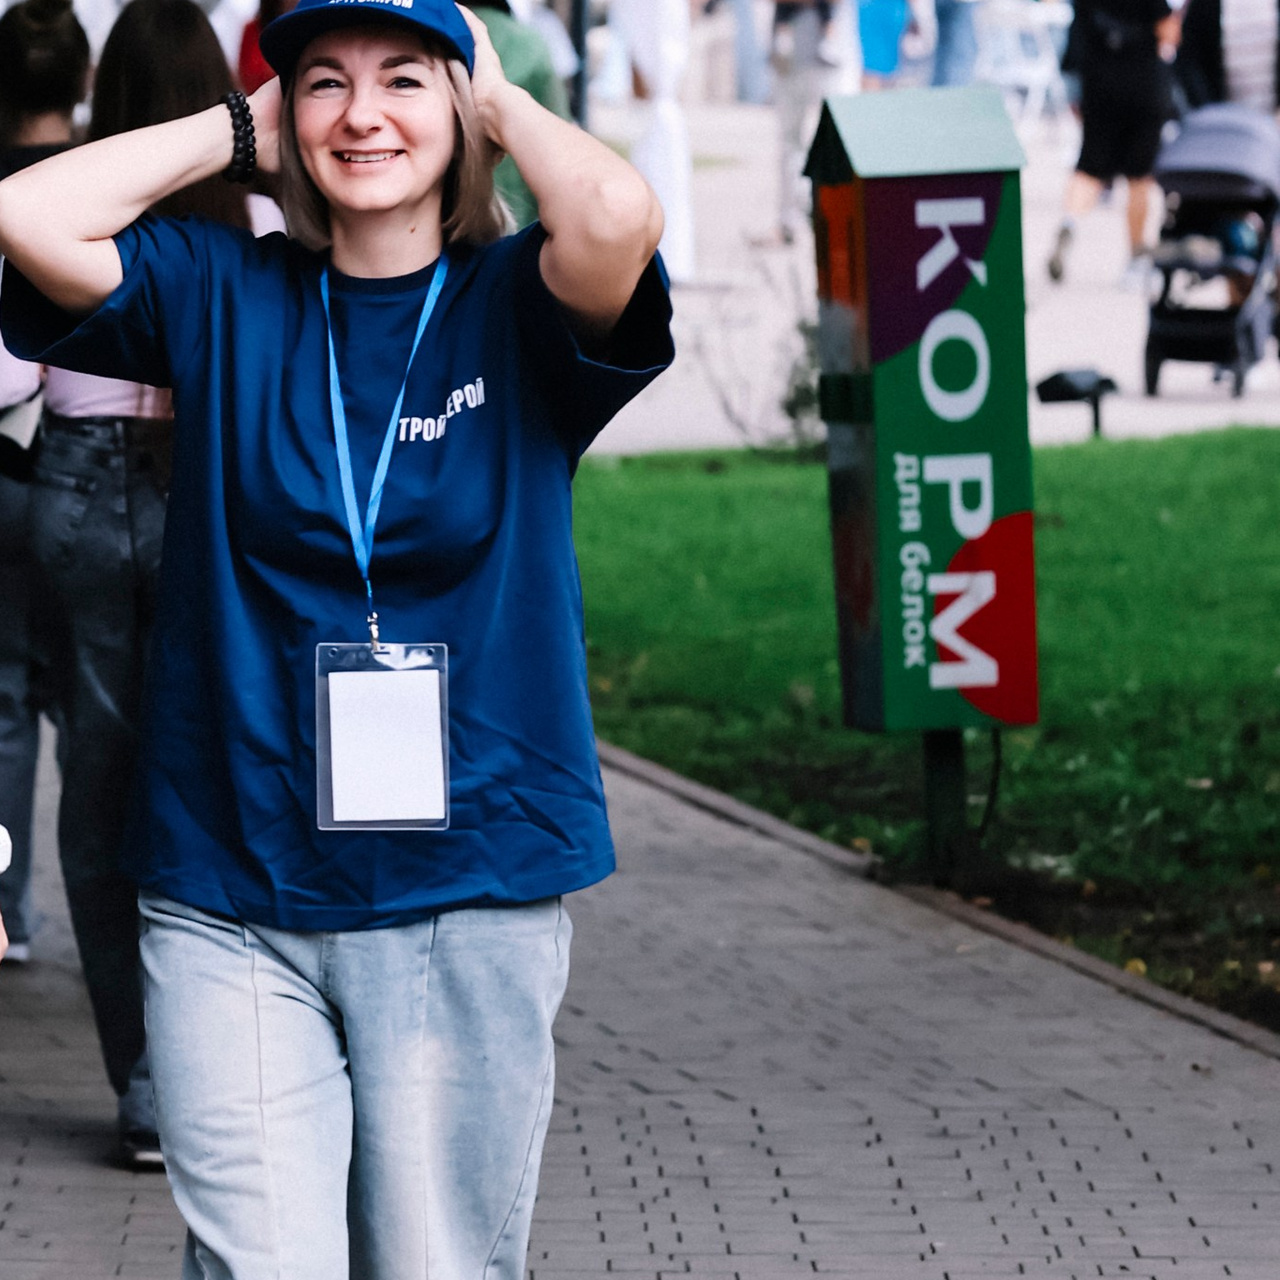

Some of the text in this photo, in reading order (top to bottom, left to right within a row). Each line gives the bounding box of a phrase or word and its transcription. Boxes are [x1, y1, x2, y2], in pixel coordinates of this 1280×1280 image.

[893, 451, 932, 669] для белок
[915, 197, 999, 689] КОРМ
